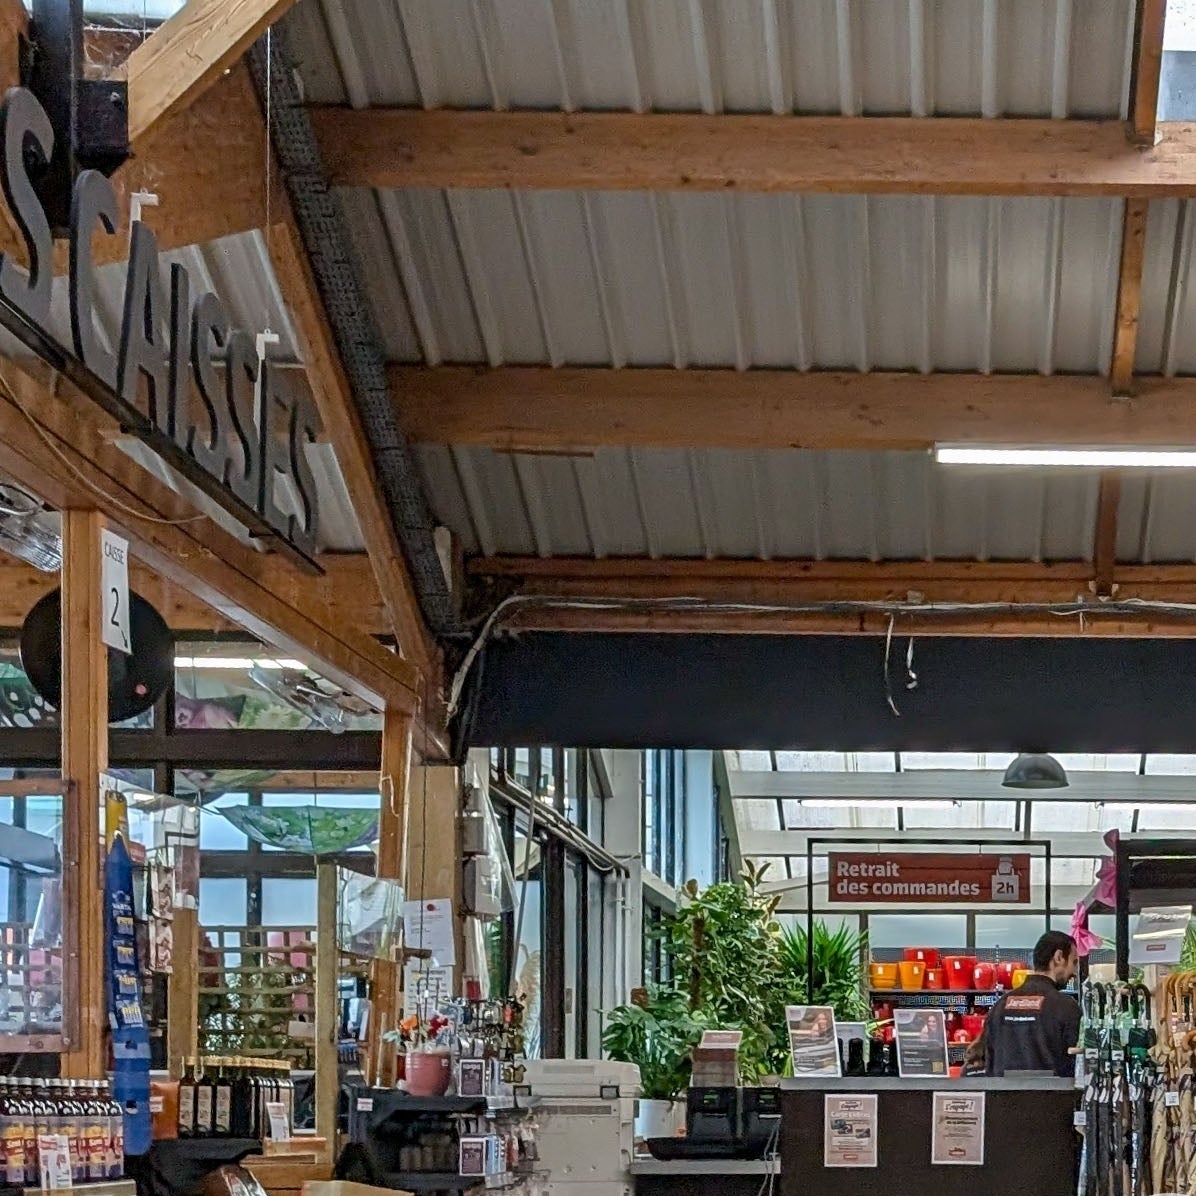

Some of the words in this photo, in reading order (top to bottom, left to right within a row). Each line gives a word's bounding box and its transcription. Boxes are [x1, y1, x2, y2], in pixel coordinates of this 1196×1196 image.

[69, 168, 325, 553] CAISSES
[104, 542, 124, 565] CAISSE
[111, 587, 119, 627] 2
[837, 861, 900, 877] Retrait
[837, 879, 868, 895] des
[873, 879, 981, 896] commandes
[996, 881, 1015, 895] 2h
